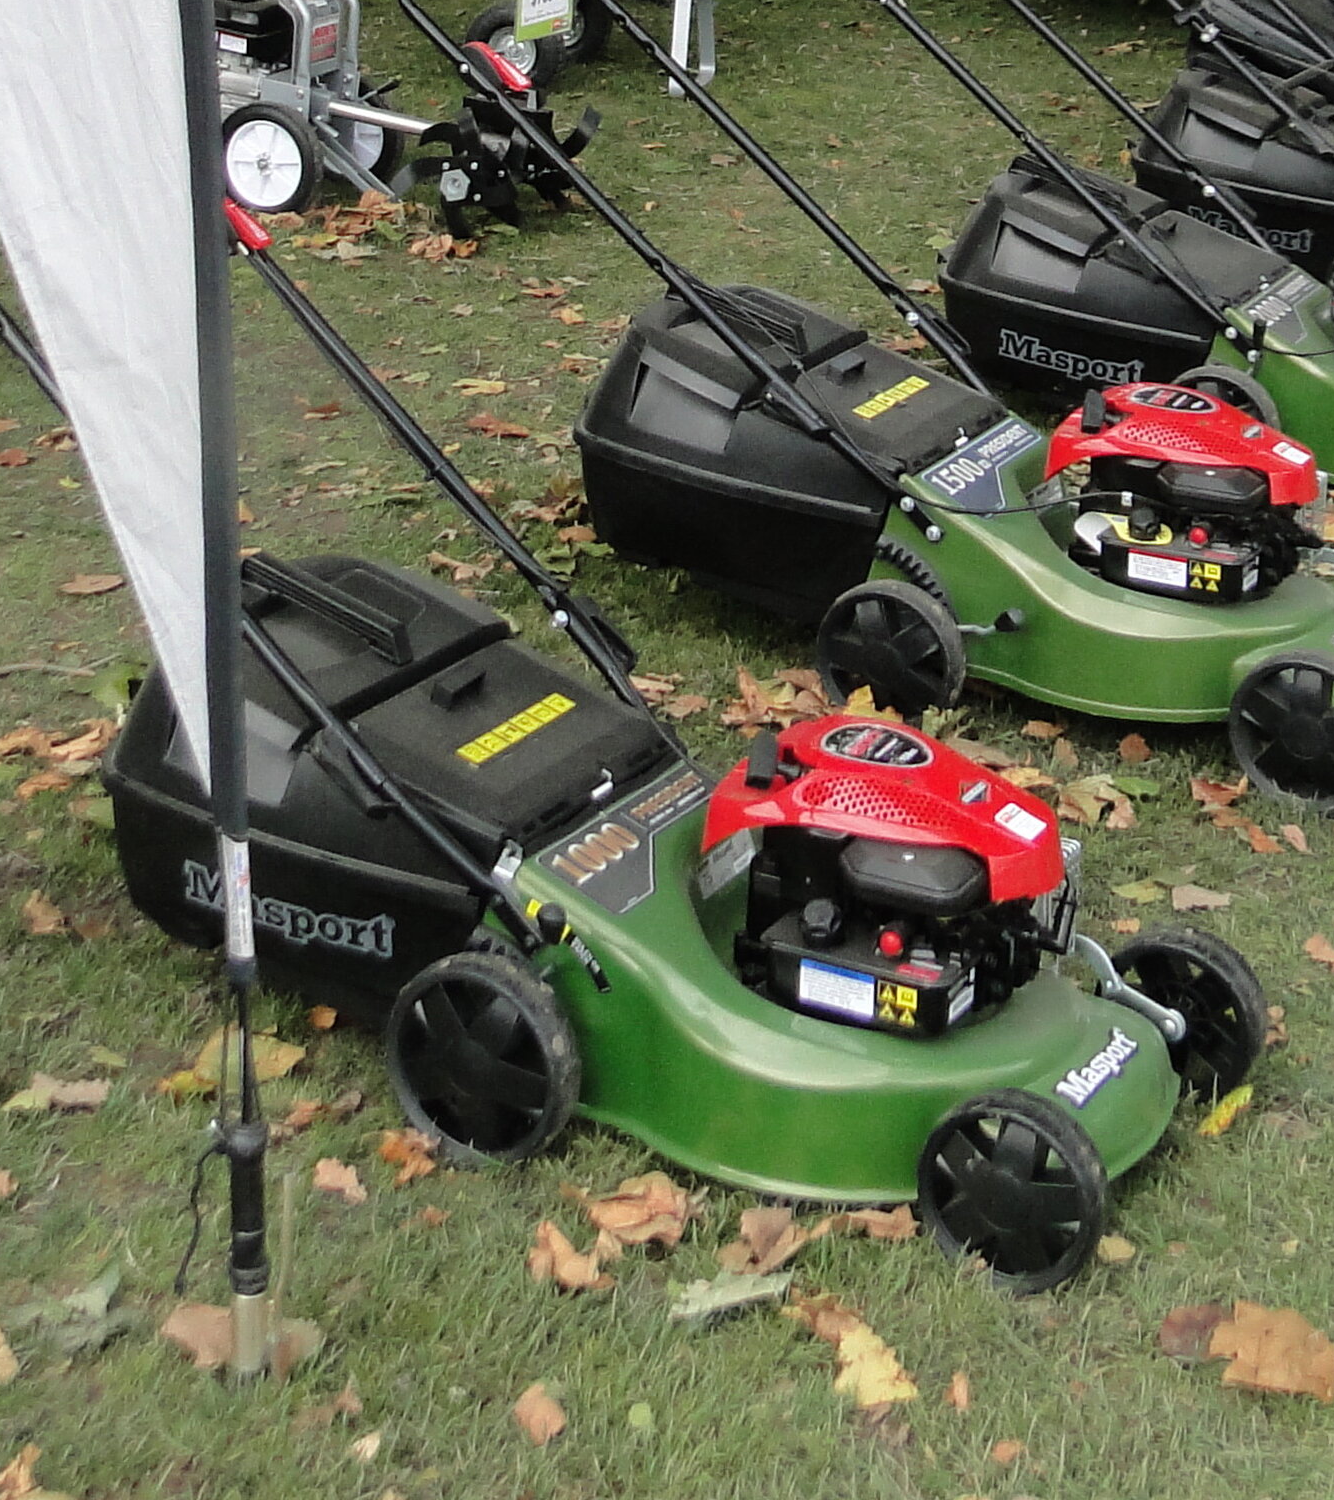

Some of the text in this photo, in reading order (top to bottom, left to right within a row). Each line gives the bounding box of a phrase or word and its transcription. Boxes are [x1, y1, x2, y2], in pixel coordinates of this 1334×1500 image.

[1188, 205, 1314, 253] Maort
[998, 328, 1145, 385] Masport
[930, 457, 985, 497] 1500
[551, 822, 641, 886] 1000
[183, 858, 396, 959] Msport
[1055, 1026, 1139, 1107] Masport
